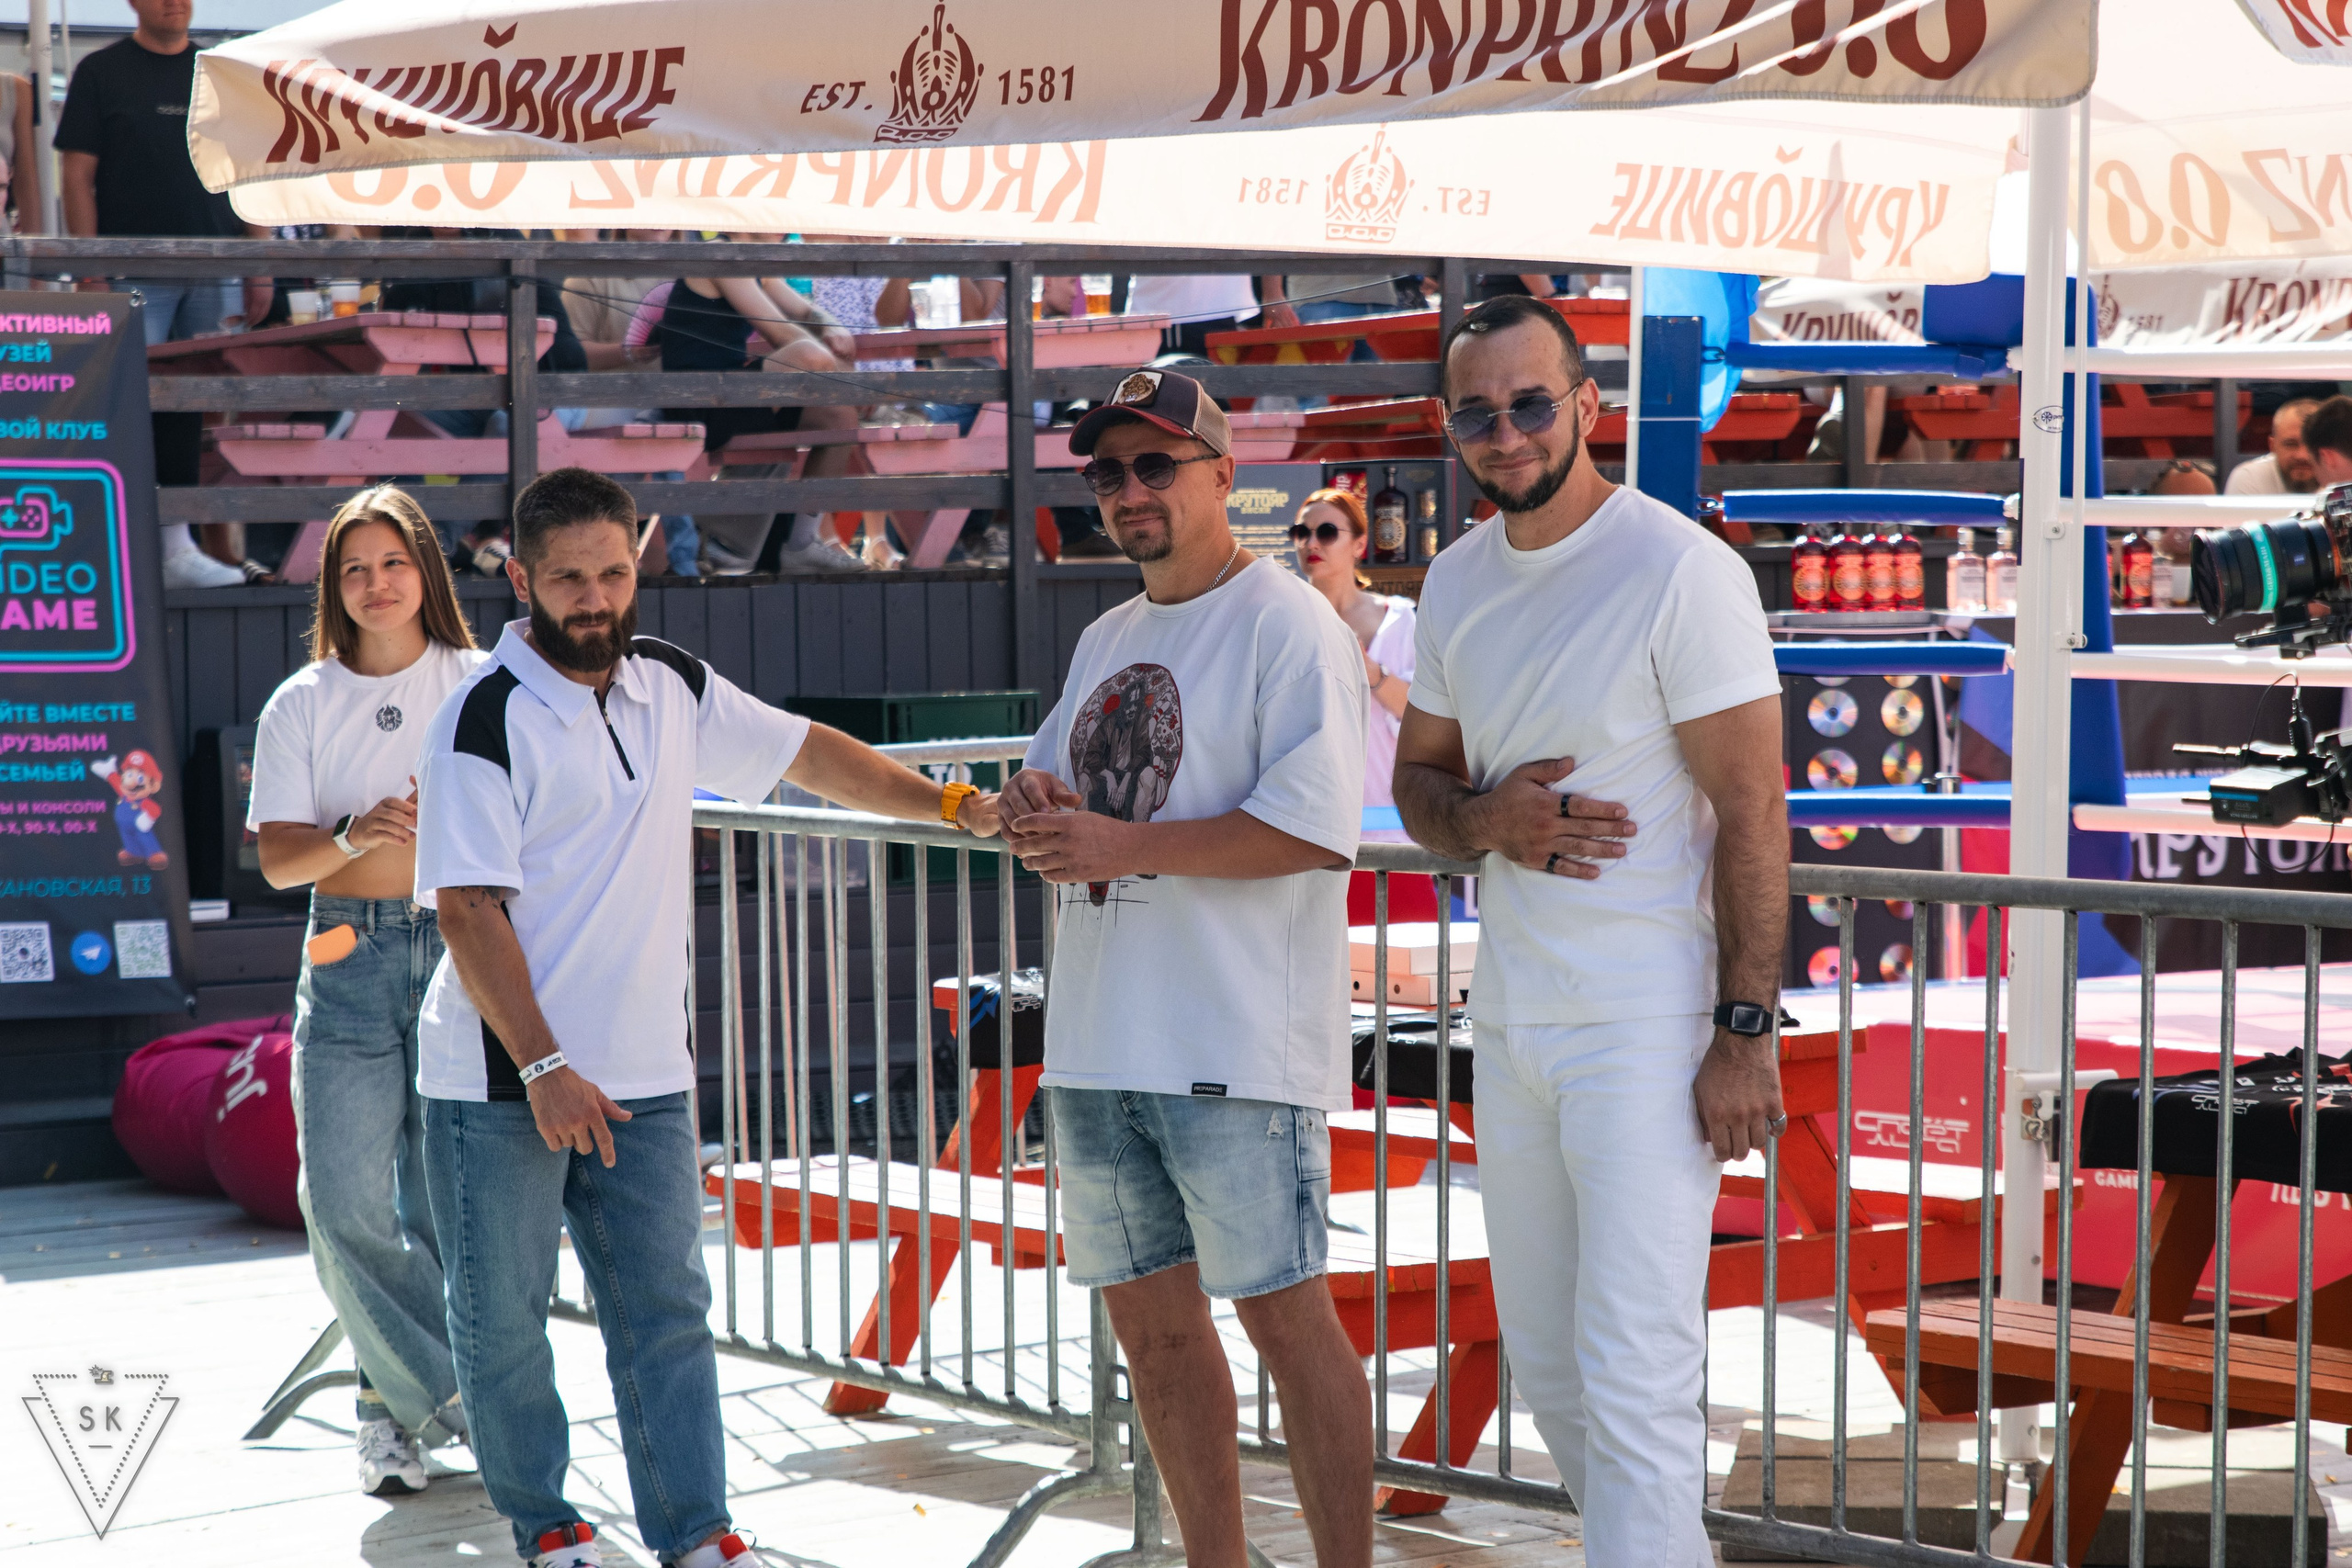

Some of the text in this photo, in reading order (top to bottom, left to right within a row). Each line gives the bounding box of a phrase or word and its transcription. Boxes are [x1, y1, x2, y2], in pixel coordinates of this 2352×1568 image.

[1190, 0, 1753, 122] KRONPRINZ
[800, 64, 1075, 114] EST. 1581
[46, 421, 108, 440] КЛУБ
[45, 702, 136, 723] ВМЕСТЕ
[31, 797, 107, 814] КОНСОЛИ
[132, 874, 152, 895] 13
